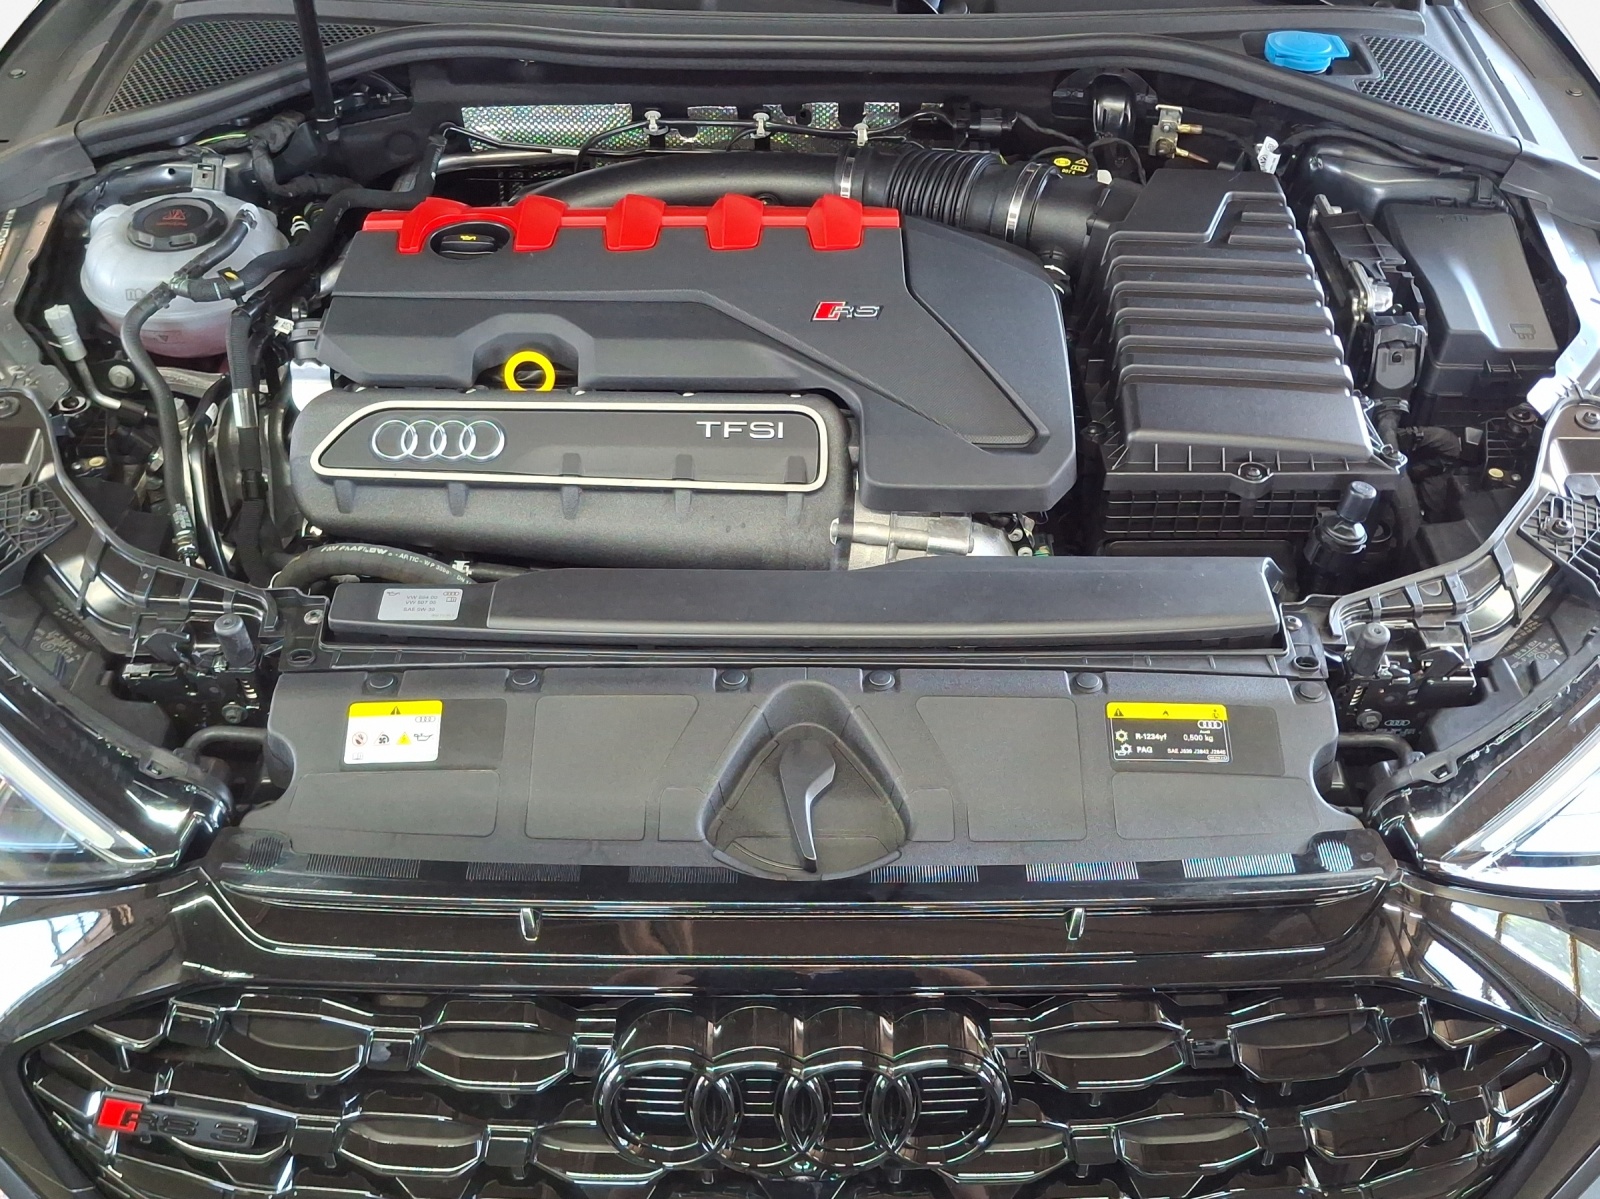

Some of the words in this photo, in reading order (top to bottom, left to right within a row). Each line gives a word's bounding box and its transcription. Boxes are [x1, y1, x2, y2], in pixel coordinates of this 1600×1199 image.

[822, 303, 880, 319] RS
[696, 421, 784, 439] TFSI
[1135, 732, 1167, 742] R-1234yf
[1183, 733, 1204, 742] 0,500
[1204, 734, 1214, 743] kg
[1136, 745, 1154, 754] PAG
[112, 1102, 199, 1138] RS
[210, 1120, 250, 1145] 3
